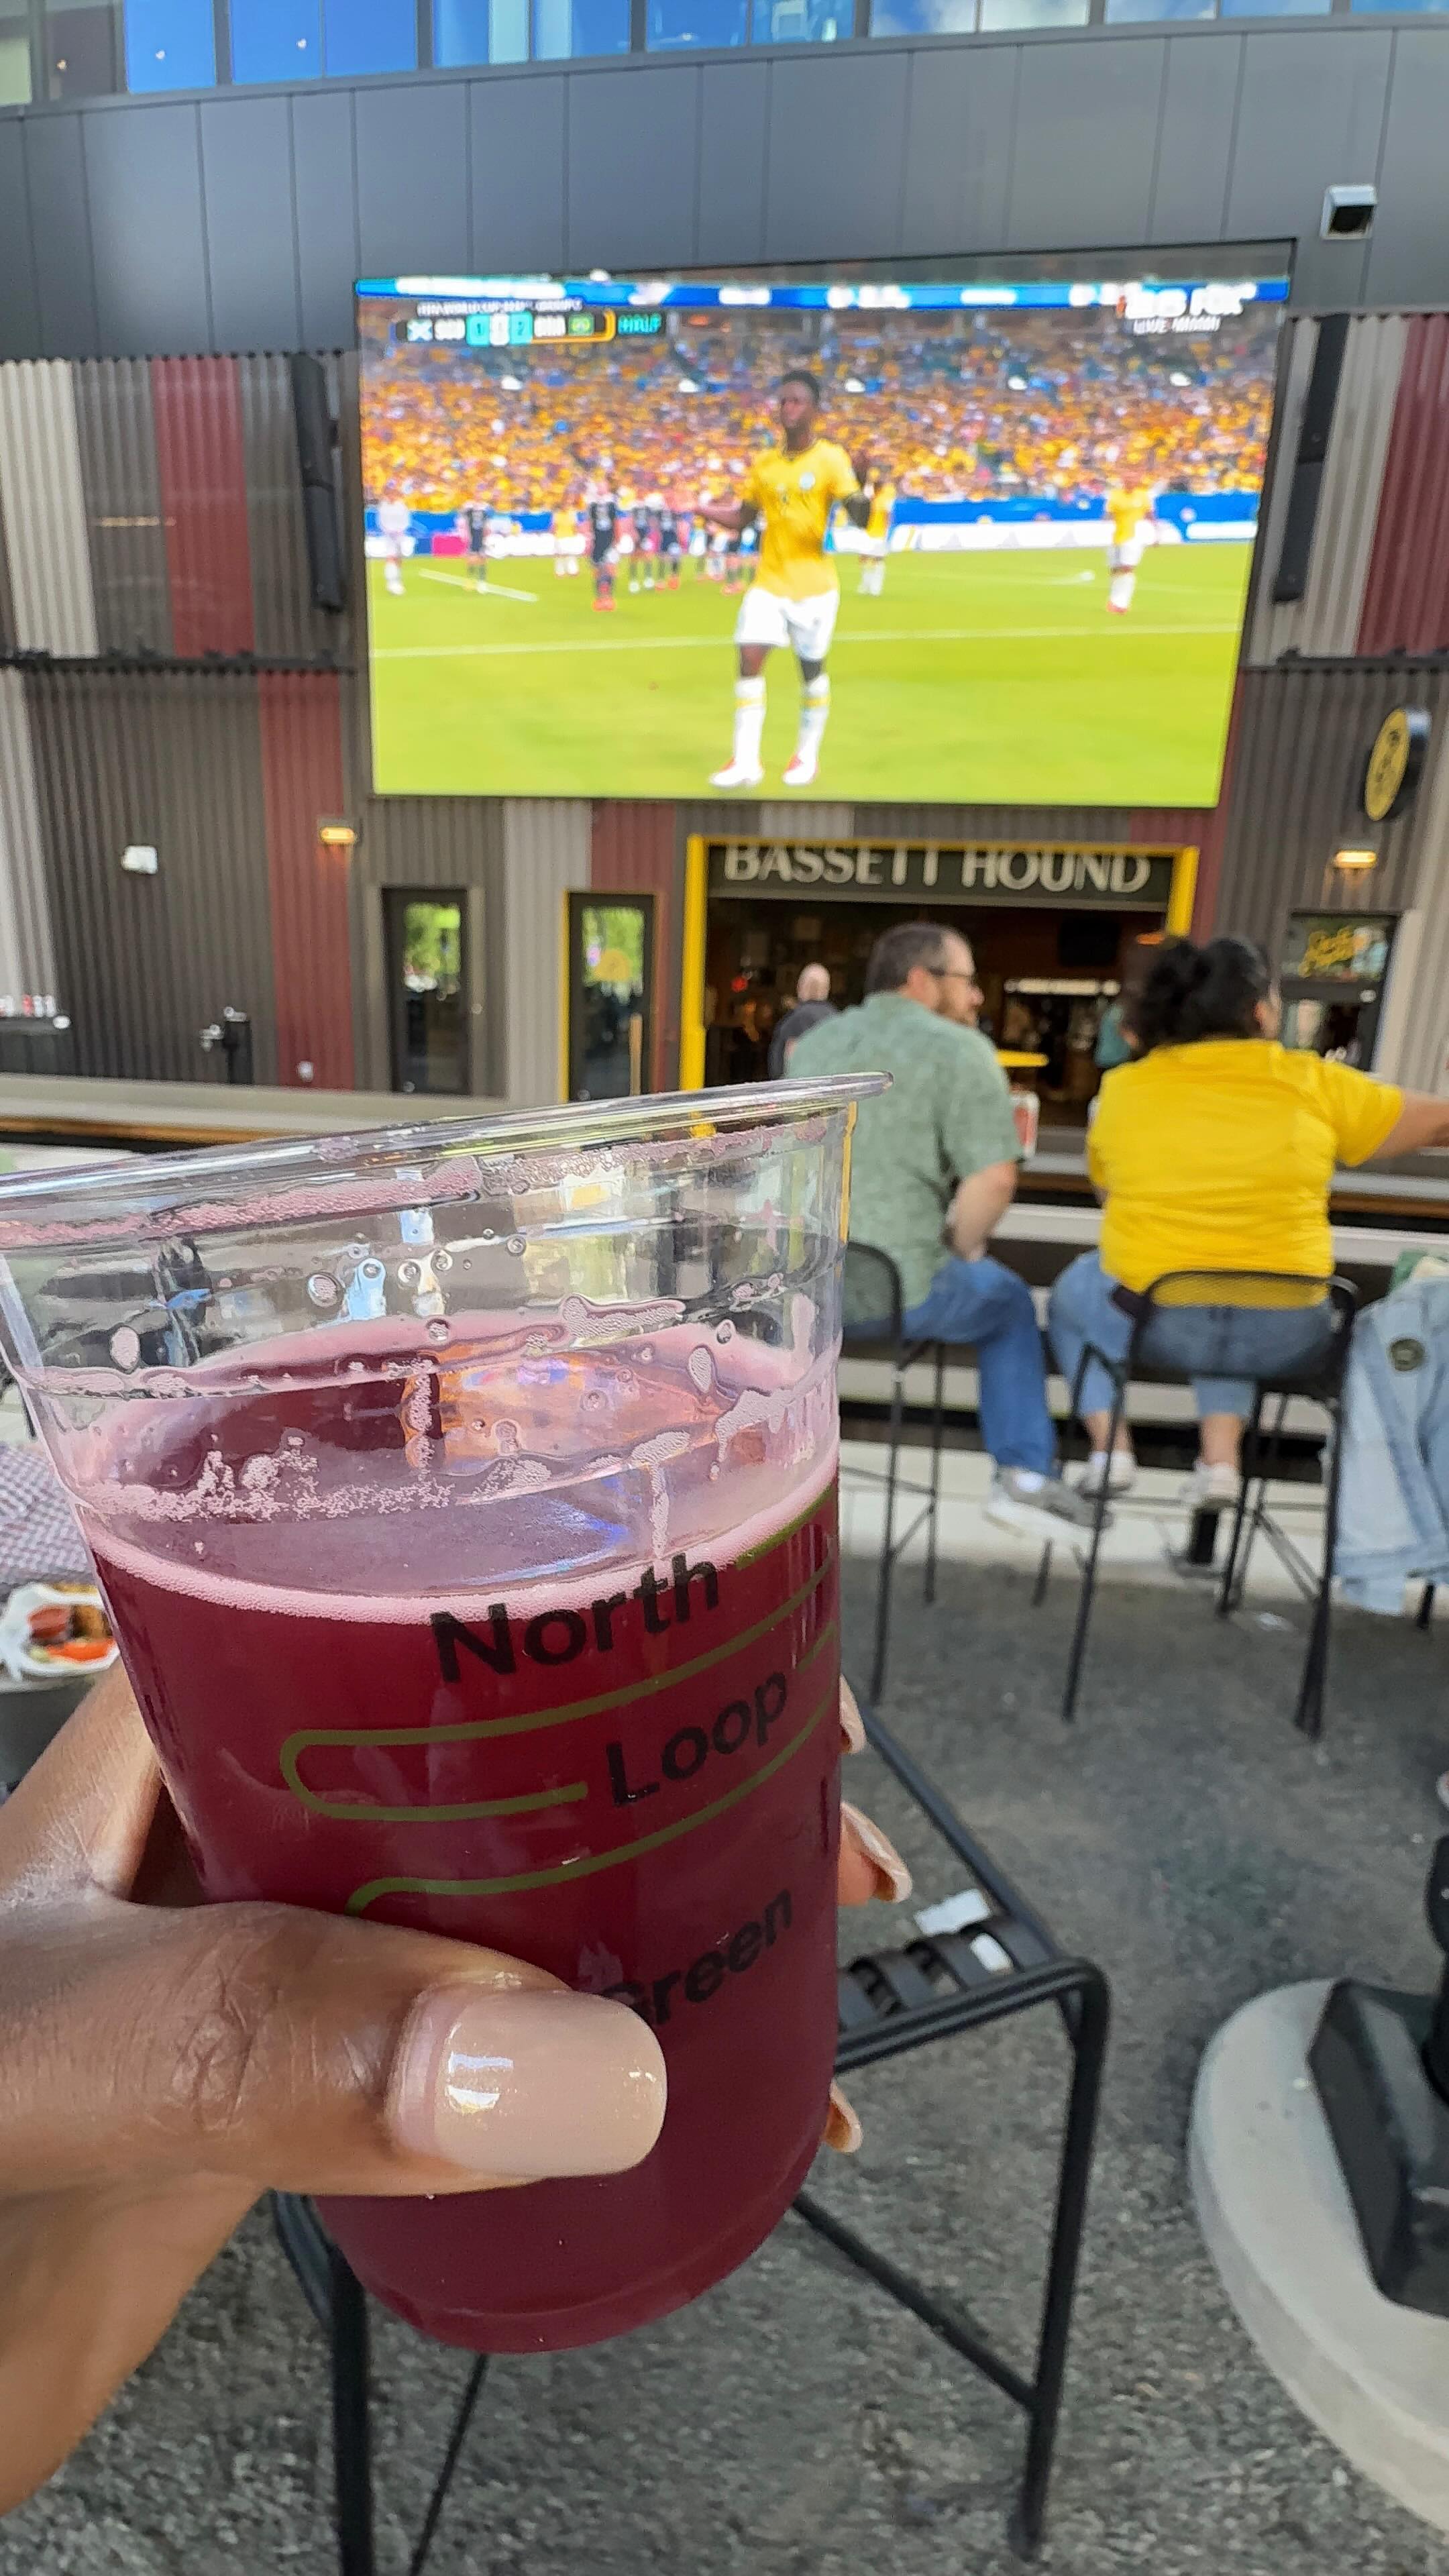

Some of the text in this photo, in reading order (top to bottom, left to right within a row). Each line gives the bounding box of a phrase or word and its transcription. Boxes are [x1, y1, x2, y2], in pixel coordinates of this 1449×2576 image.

[723, 843, 1151, 893] BASSETT HOUND
[429, 1553, 720, 1684] North
[605, 1671, 788, 1808] Loop
